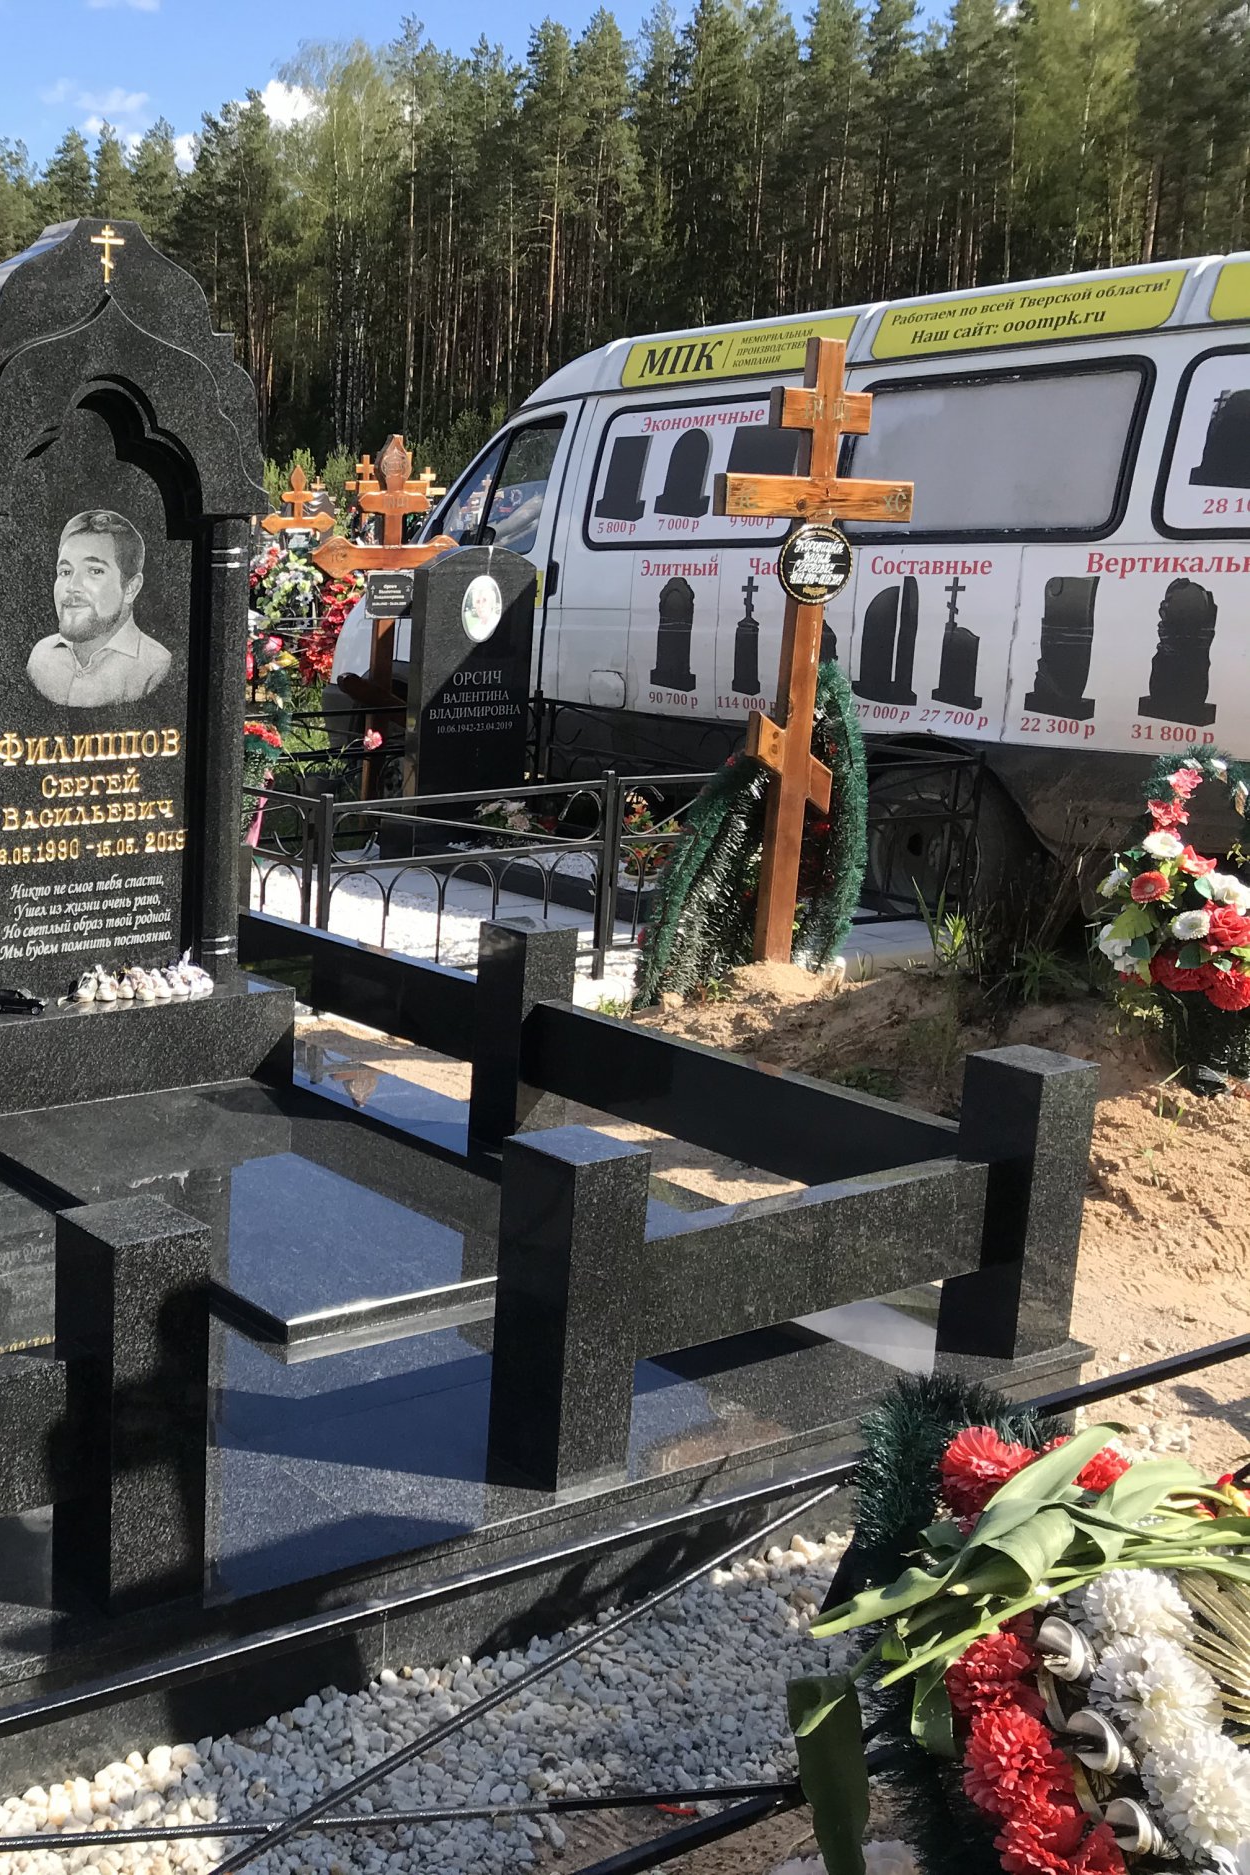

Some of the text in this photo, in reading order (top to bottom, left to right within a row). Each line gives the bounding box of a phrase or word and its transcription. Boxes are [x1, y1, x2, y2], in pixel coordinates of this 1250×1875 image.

[892, 278, 1172, 326] Работаем по всей Тверской области!
[741, 328, 813, 345] МЕМОРИАЛЬНАЯ
[911, 327, 948, 345] Наш
[953, 321, 999, 340] сайт:
[638, 340, 723, 378] МПК
[732, 355, 781, 368] КОМПАНИЯ
[640, 409, 765, 433] Экономичные
[1202, 498, 1228, 514] 28
[597, 522, 604, 534] 5
[606, 521, 626, 533] 800
[658, 518, 665, 531] 7
[666, 518, 688, 530] 000
[640, 553, 719, 577] Элитный
[871, 556, 992, 576] Составные
[452, 670, 502, 686] ОРСИЧ
[443, 690, 509, 704] ВАЛЕНТИНА
[649, 691, 663, 704] 90
[666, 692, 688, 705] 700
[717, 696, 739, 708] 114
[742, 697, 766, 710] 000
[429, 704, 521, 720] ВЛАДИМИРОВНА
[855, 704, 870, 718] 27
[873, 705, 899, 719] 000
[919, 709, 940, 722] 27
[943, 711, 974, 726] 700
[1020, 717, 1043, 732] 22
[1045, 719, 1080, 735] 300
[1131, 724, 1153, 740] 31
[1160, 726, 1197, 743] 800
[41, 767, 141, 799] СЕРГЕЙ
[1, 800, 174, 831] ВАСИЛЬЕВИЧ
[10, 874, 164, 900] Никто не смог тебя спасти,
[13, 894, 161, 921] Ушел из жизни очень рано,
[2, 908, 171, 940] Но светлый образ твой родной
[0, 930, 172, 961] Мы будем помнить постоянно.
